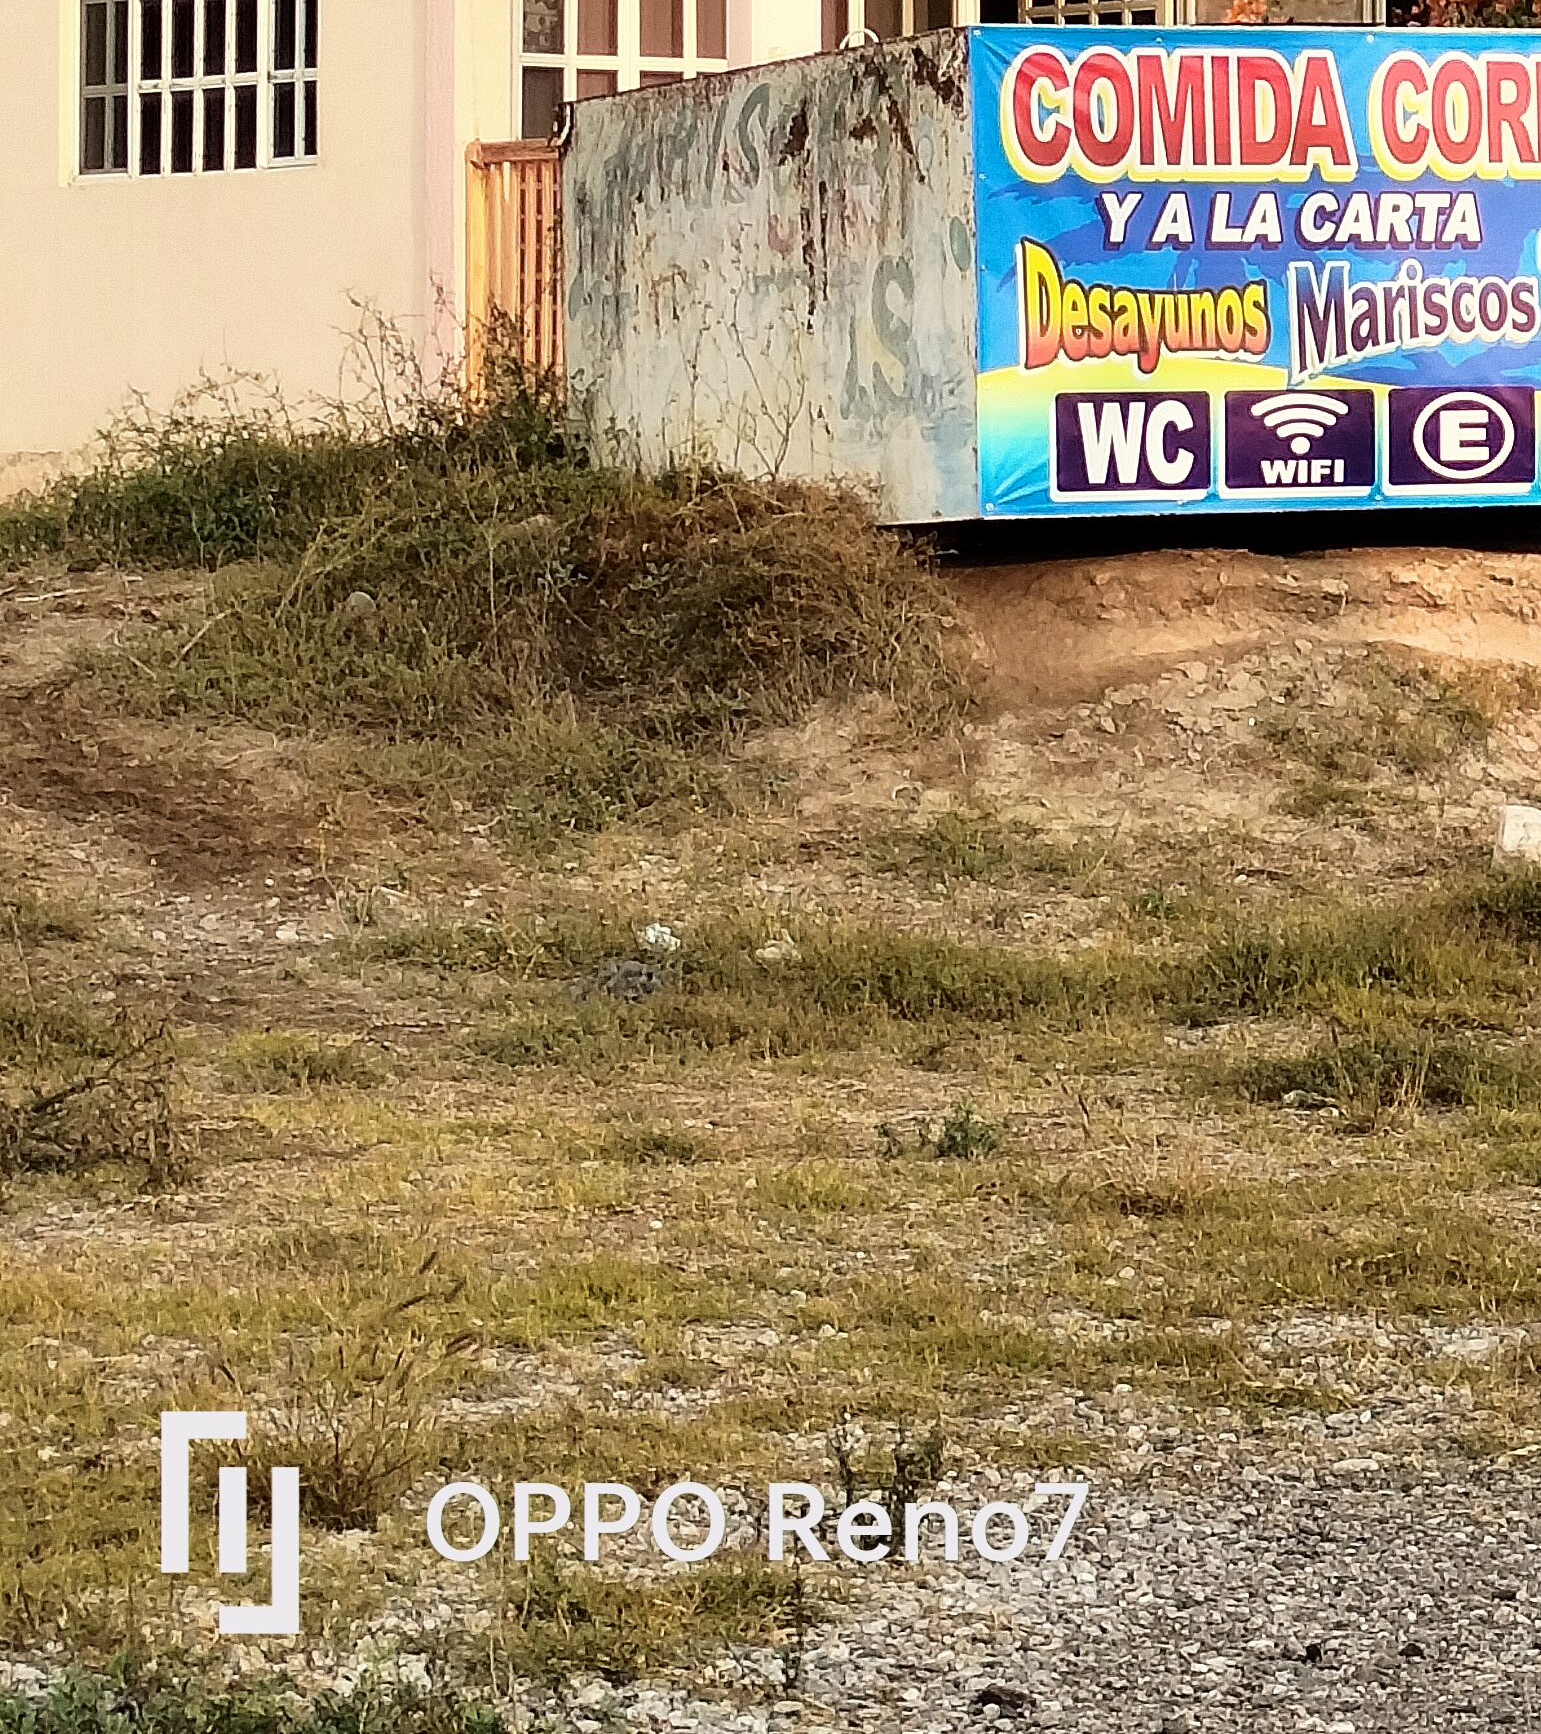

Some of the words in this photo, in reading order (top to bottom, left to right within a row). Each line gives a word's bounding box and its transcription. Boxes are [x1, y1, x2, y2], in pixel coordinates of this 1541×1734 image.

[1009, 50, 1354, 169] COMIDA
[1100, 191, 1142, 245] Y
[1151, 191, 1194, 245] A
[1210, 191, 1284, 245] LA
[1299, 191, 1483, 245] CARTA
[1022, 237, 1270, 373] Desayunos
[1290, 261, 1538, 375] Mariscos
[1077, 400, 1195, 484] WC
[1260, 458, 1345, 484] WIFI
[1439, 409, 1490, 462] E
